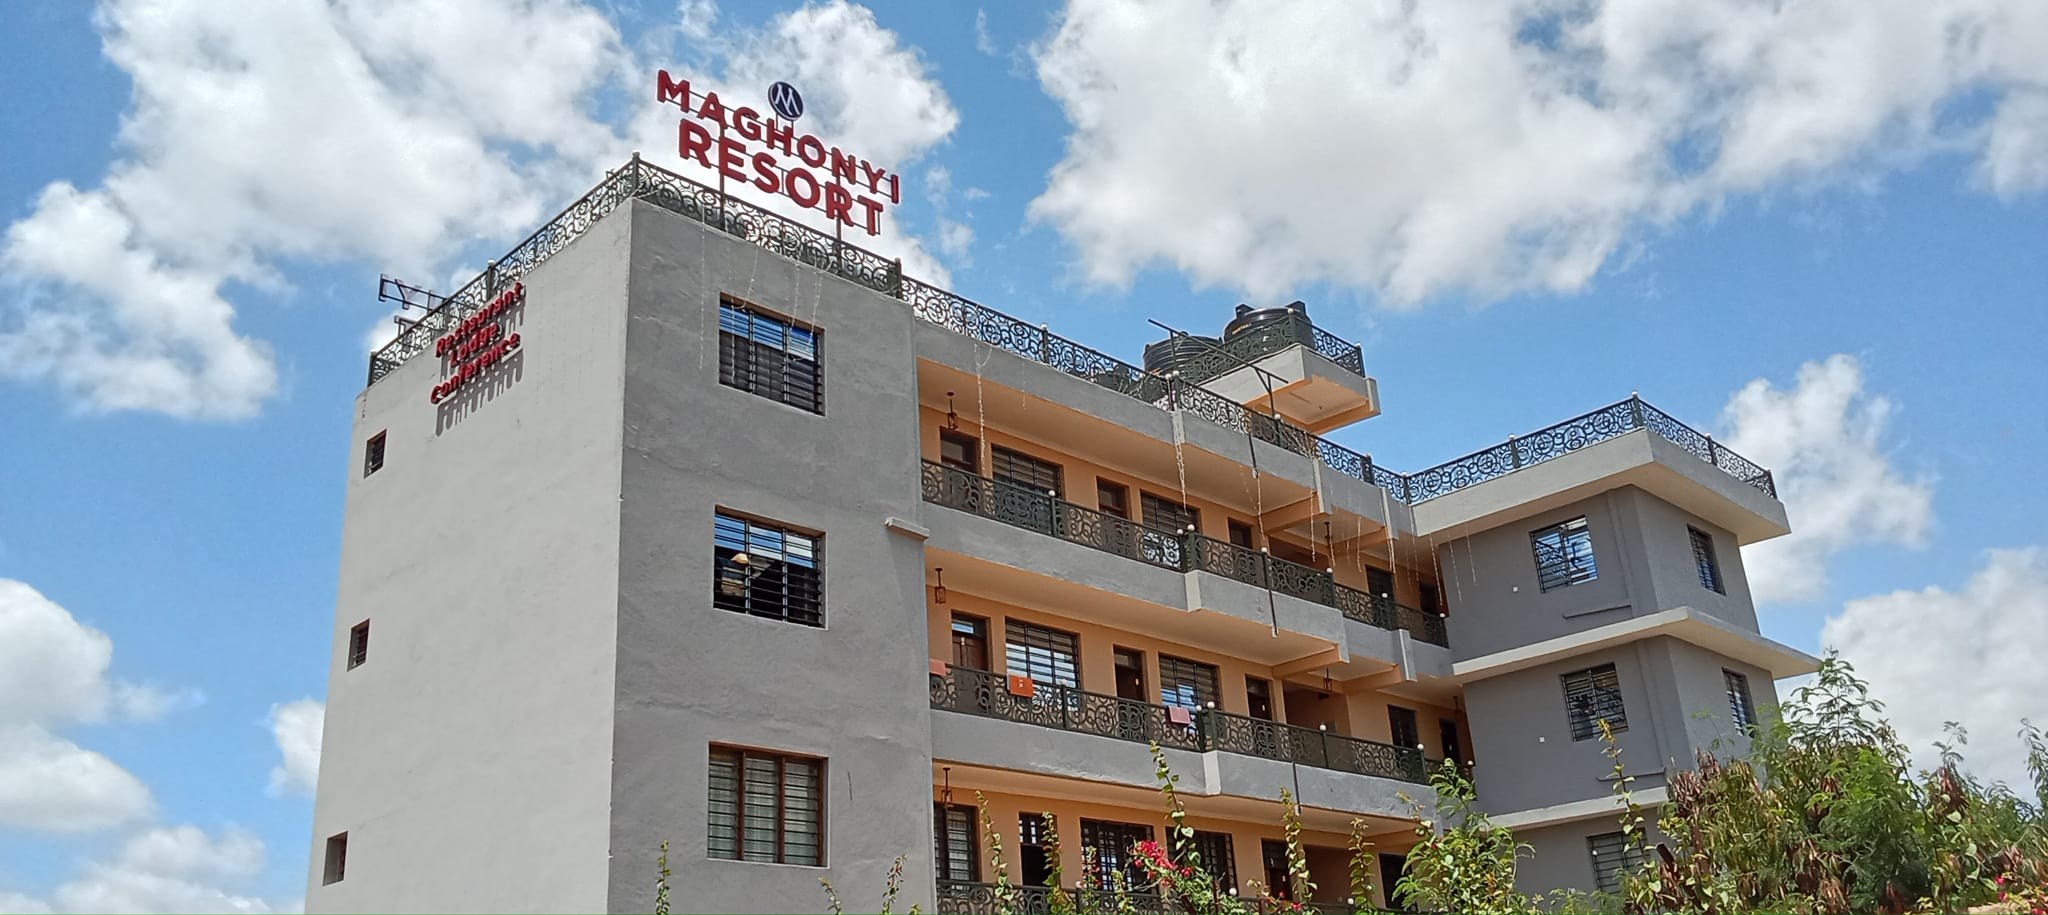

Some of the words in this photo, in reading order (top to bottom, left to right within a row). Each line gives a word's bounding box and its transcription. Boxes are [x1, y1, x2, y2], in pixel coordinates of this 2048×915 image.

[657, 69, 899, 204] MAGHONYI
[773, 83, 800, 117] M
[679, 118, 884, 236] RESORT
[435, 281, 524, 358] Restaurant
[450, 322, 500, 368] Lodge
[430, 332, 521, 405] Conference
